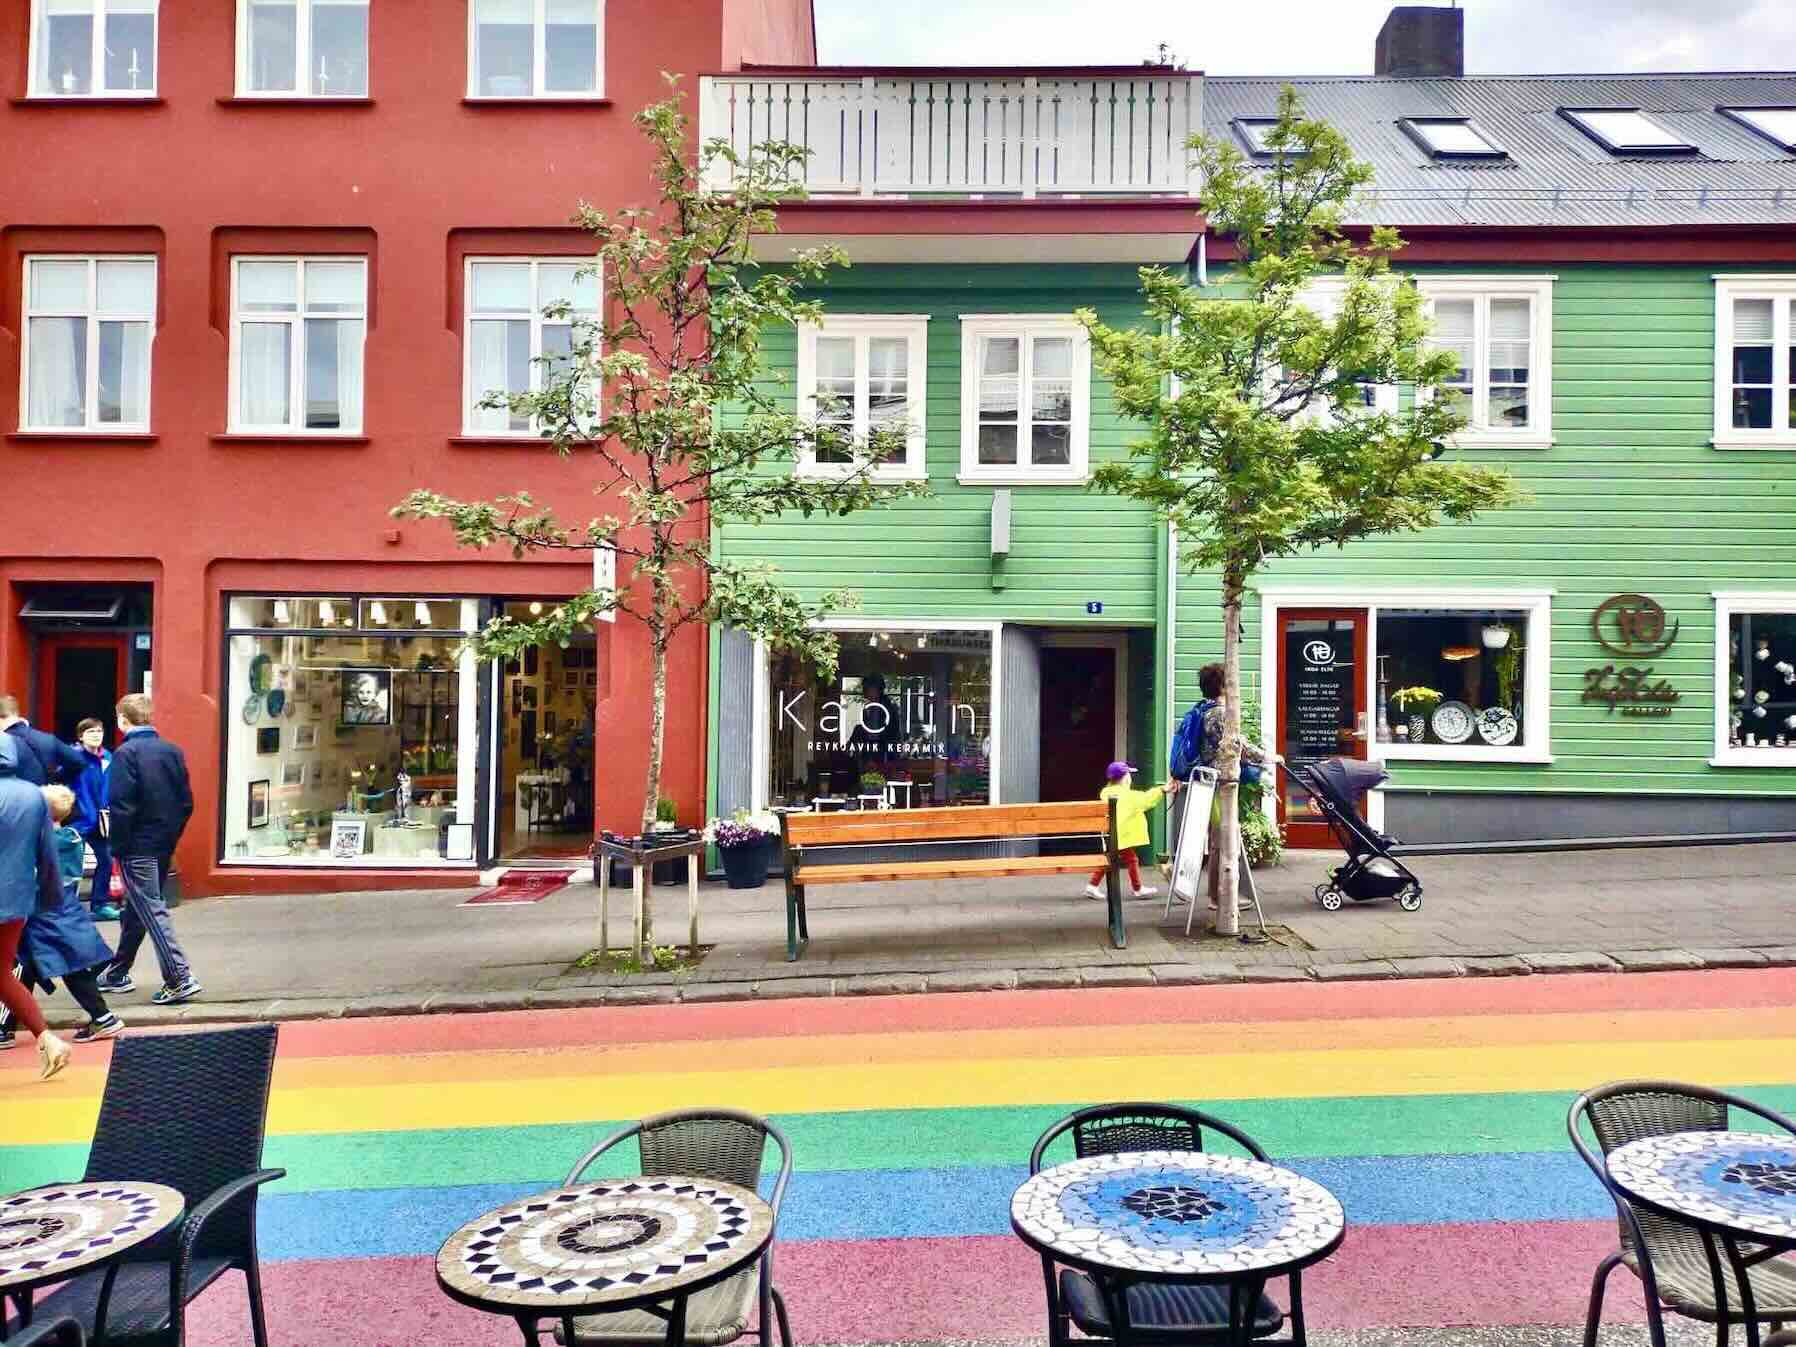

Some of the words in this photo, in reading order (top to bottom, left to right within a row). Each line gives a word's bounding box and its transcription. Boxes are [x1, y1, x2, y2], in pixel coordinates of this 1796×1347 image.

[778, 688, 976, 734] Kaolin
[807, 741, 879, 752] REYKJAVIK
[887, 741, 945, 753] KERAMIK
